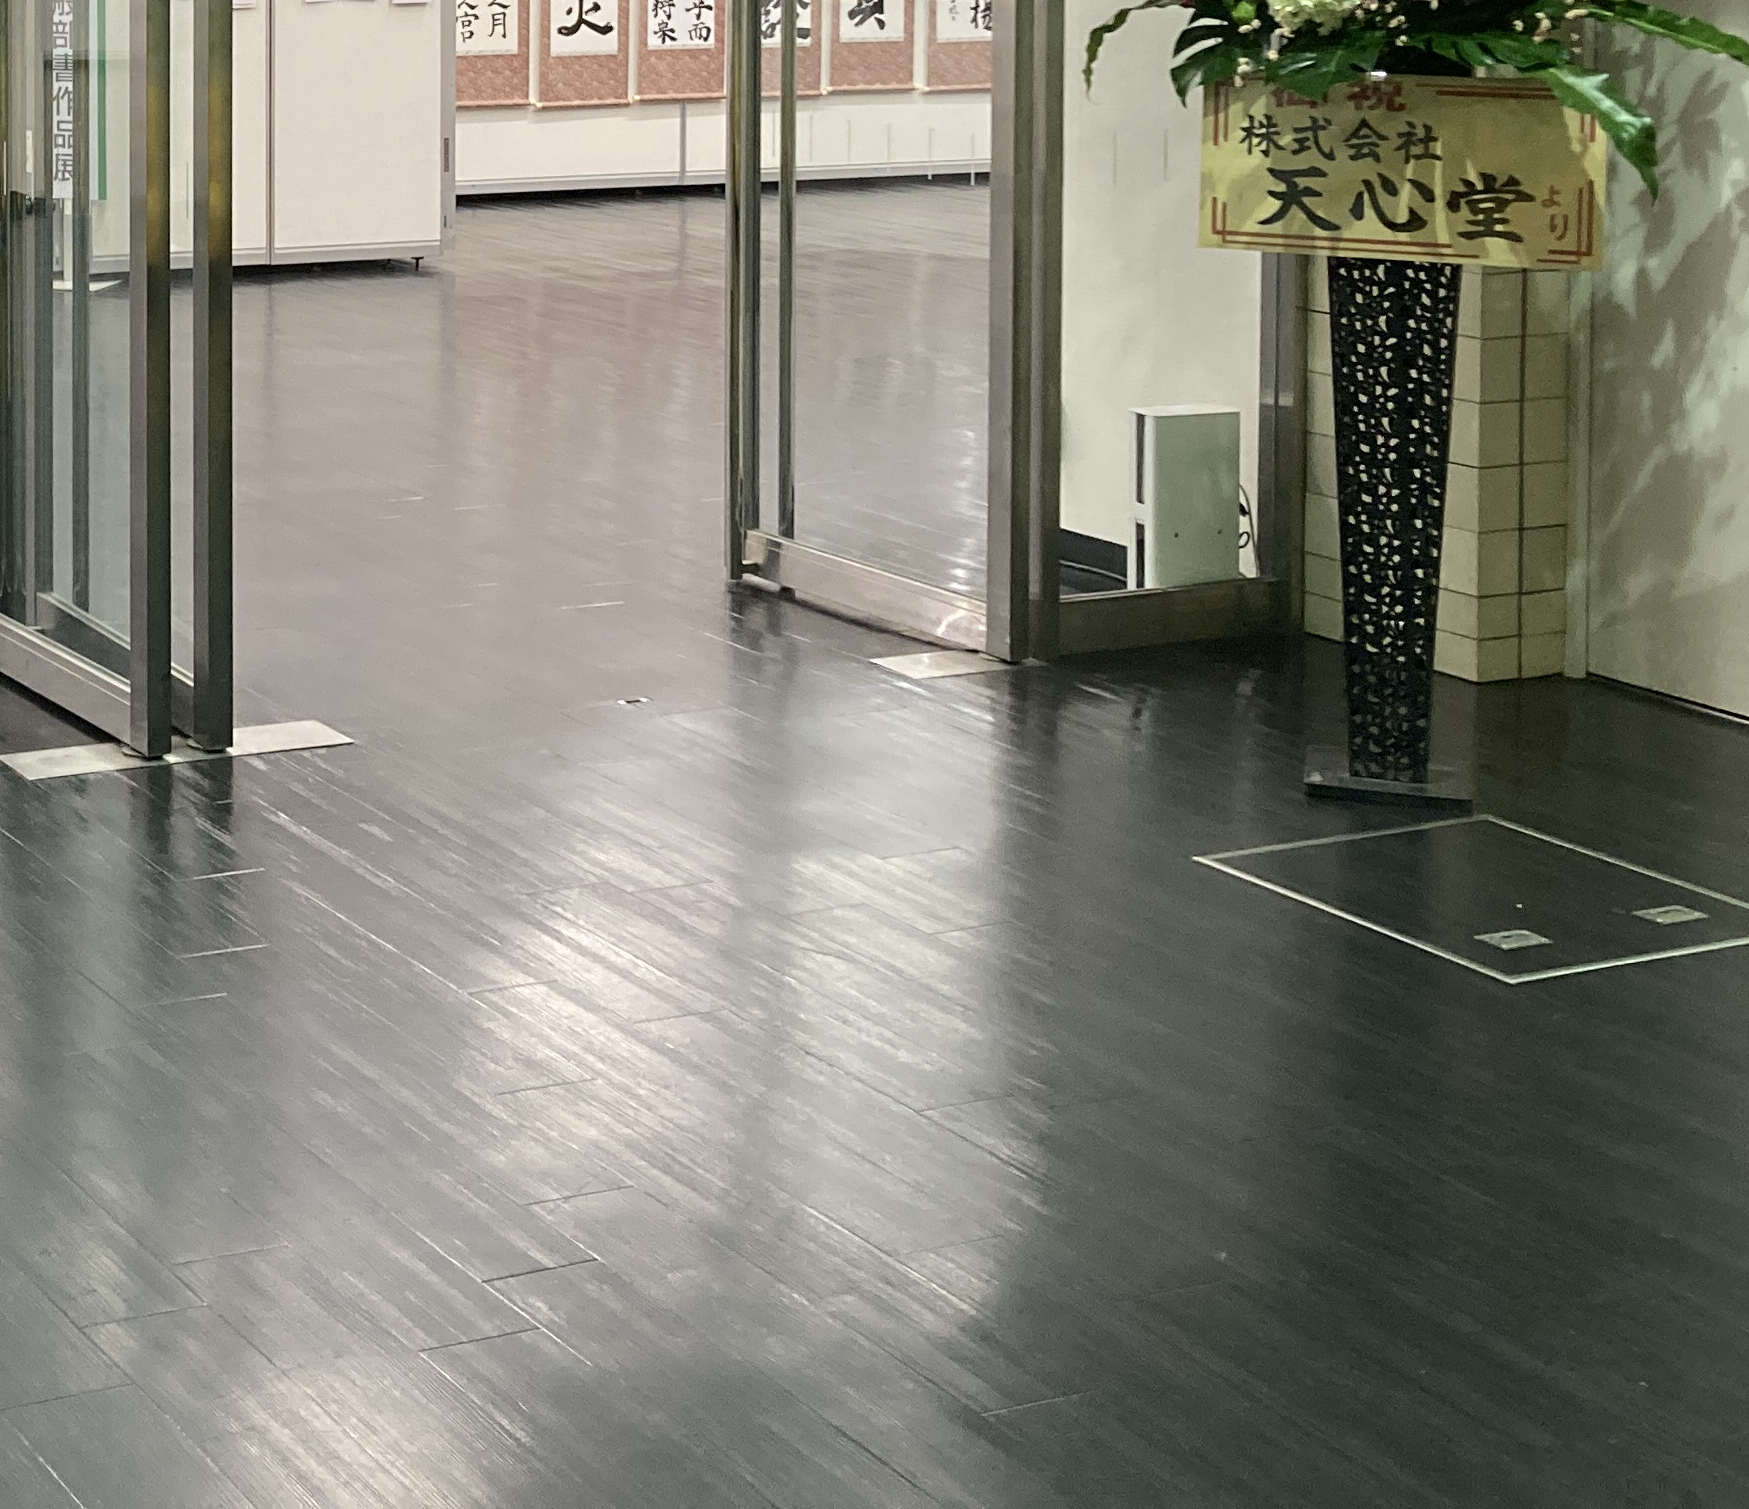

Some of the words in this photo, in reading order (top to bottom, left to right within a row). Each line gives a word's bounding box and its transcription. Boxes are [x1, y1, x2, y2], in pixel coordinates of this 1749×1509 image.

[1239, 113, 1443, 165] 株式会社
[1258, 166, 1536, 243] 天心堂
[1541, 184, 1570, 241] より
